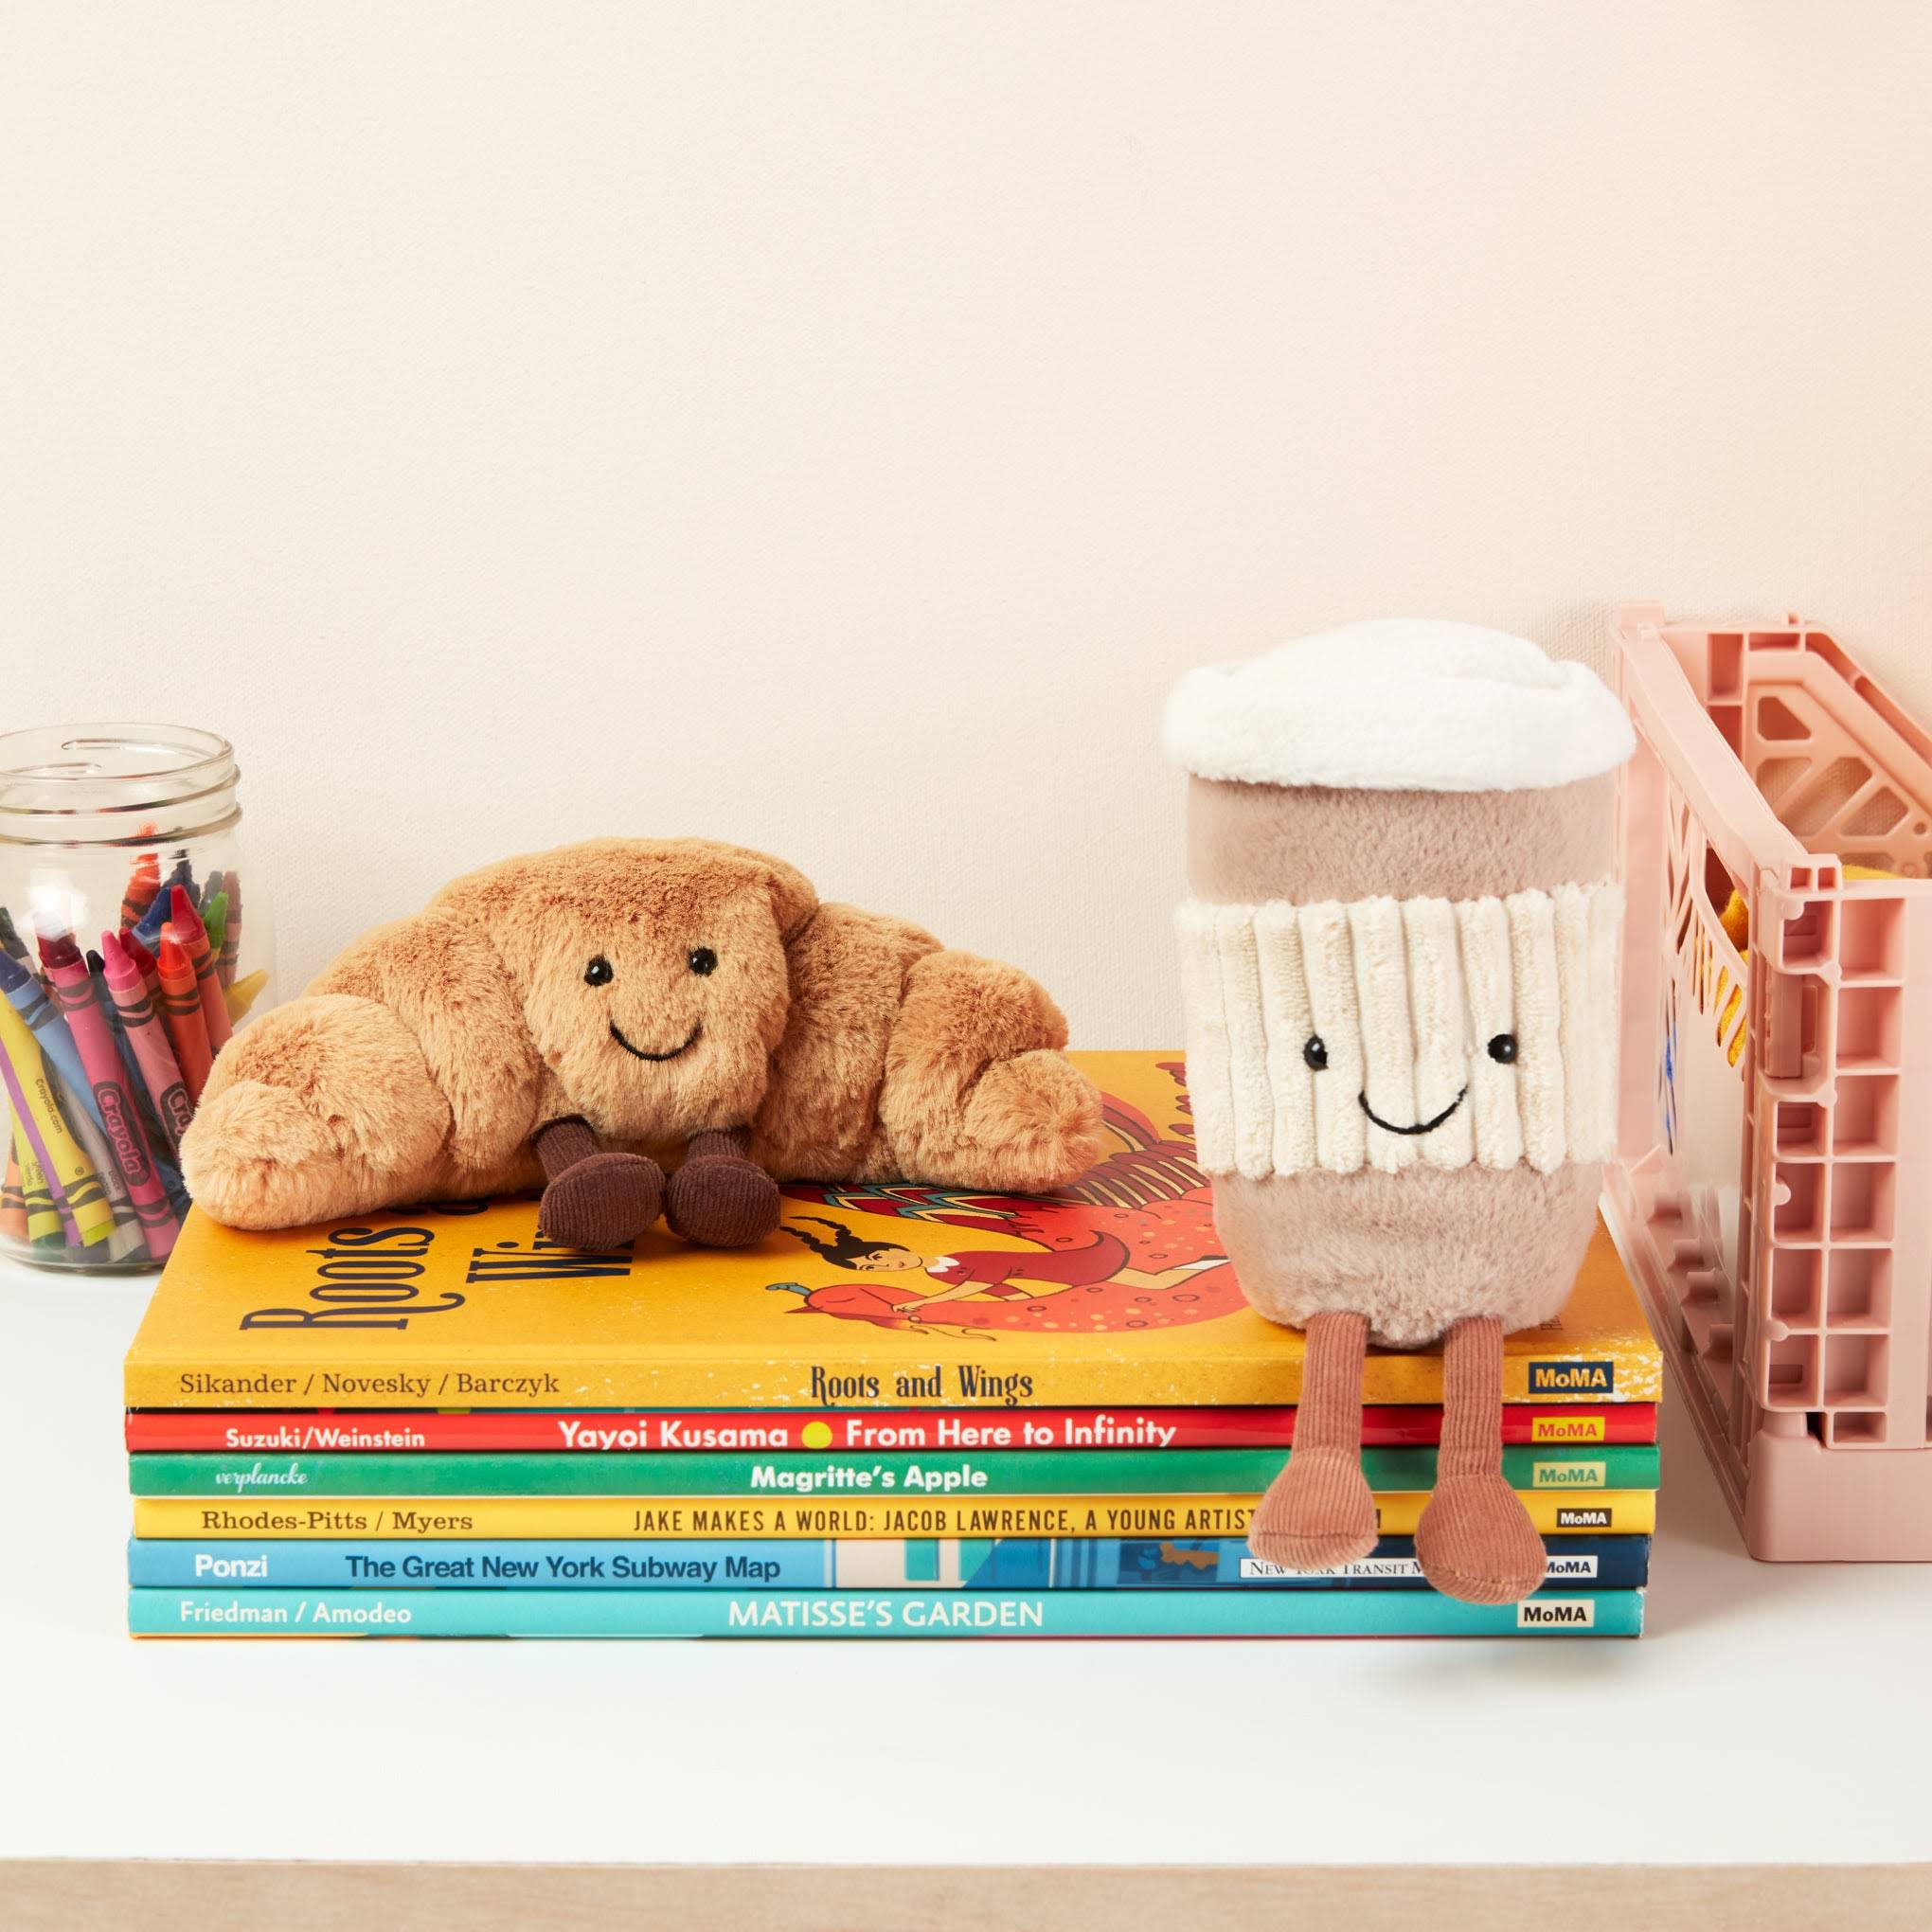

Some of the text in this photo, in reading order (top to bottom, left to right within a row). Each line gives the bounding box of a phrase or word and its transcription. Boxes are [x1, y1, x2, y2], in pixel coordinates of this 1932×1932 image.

[98, 1087, 141, 1173] Crayola
[239, 1226, 466, 1330] Roots
[181, 1373, 559, 1398] Sikander / Novesky / Barczyk
[812, 1366, 1033, 1405] Roots and Wings
[1536, 1368, 1607, 1386] MoMA
[226, 1426, 424, 1448] Suzuki/Weinstein
[559, 1415, 1176, 1449] Yayoi Kusama From Here to Infinity
[1538, 1423, 1597, 1437] MoMA
[216, 1462, 307, 1493] verplancke
[903, 1464, 987, 1492] Apple
[1539, 1469, 1598, 1482] MoMA
[202, 1512, 473, 1533] Rhodes-Pitts / Myers
[635, 1511, 682, 1530] JAKE
[693, 1511, 763, 1530] MAKES
[775, 1512, 785, 1530] A
[796, 1511, 873, 1530] WORLD:
[885, 1511, 946, 1530] JACOB
[957, 1510, 1075, 1532] LAWRENCE,
[1085, 1510, 1097, 1530] A
[1108, 1510, 1174, 1530] YOUNG
[1561, 1512, 1606, 1524] MoMA
[195, 1554, 267, 1577] Ponzi
[346, 1556, 780, 1583] The Great New York Subway Map
[181, 1601, 411, 1622] Friedman / Amodeo
[903, 1601, 1042, 1626] GARDEN
[1525, 1607, 1586, 1621] MoMA
